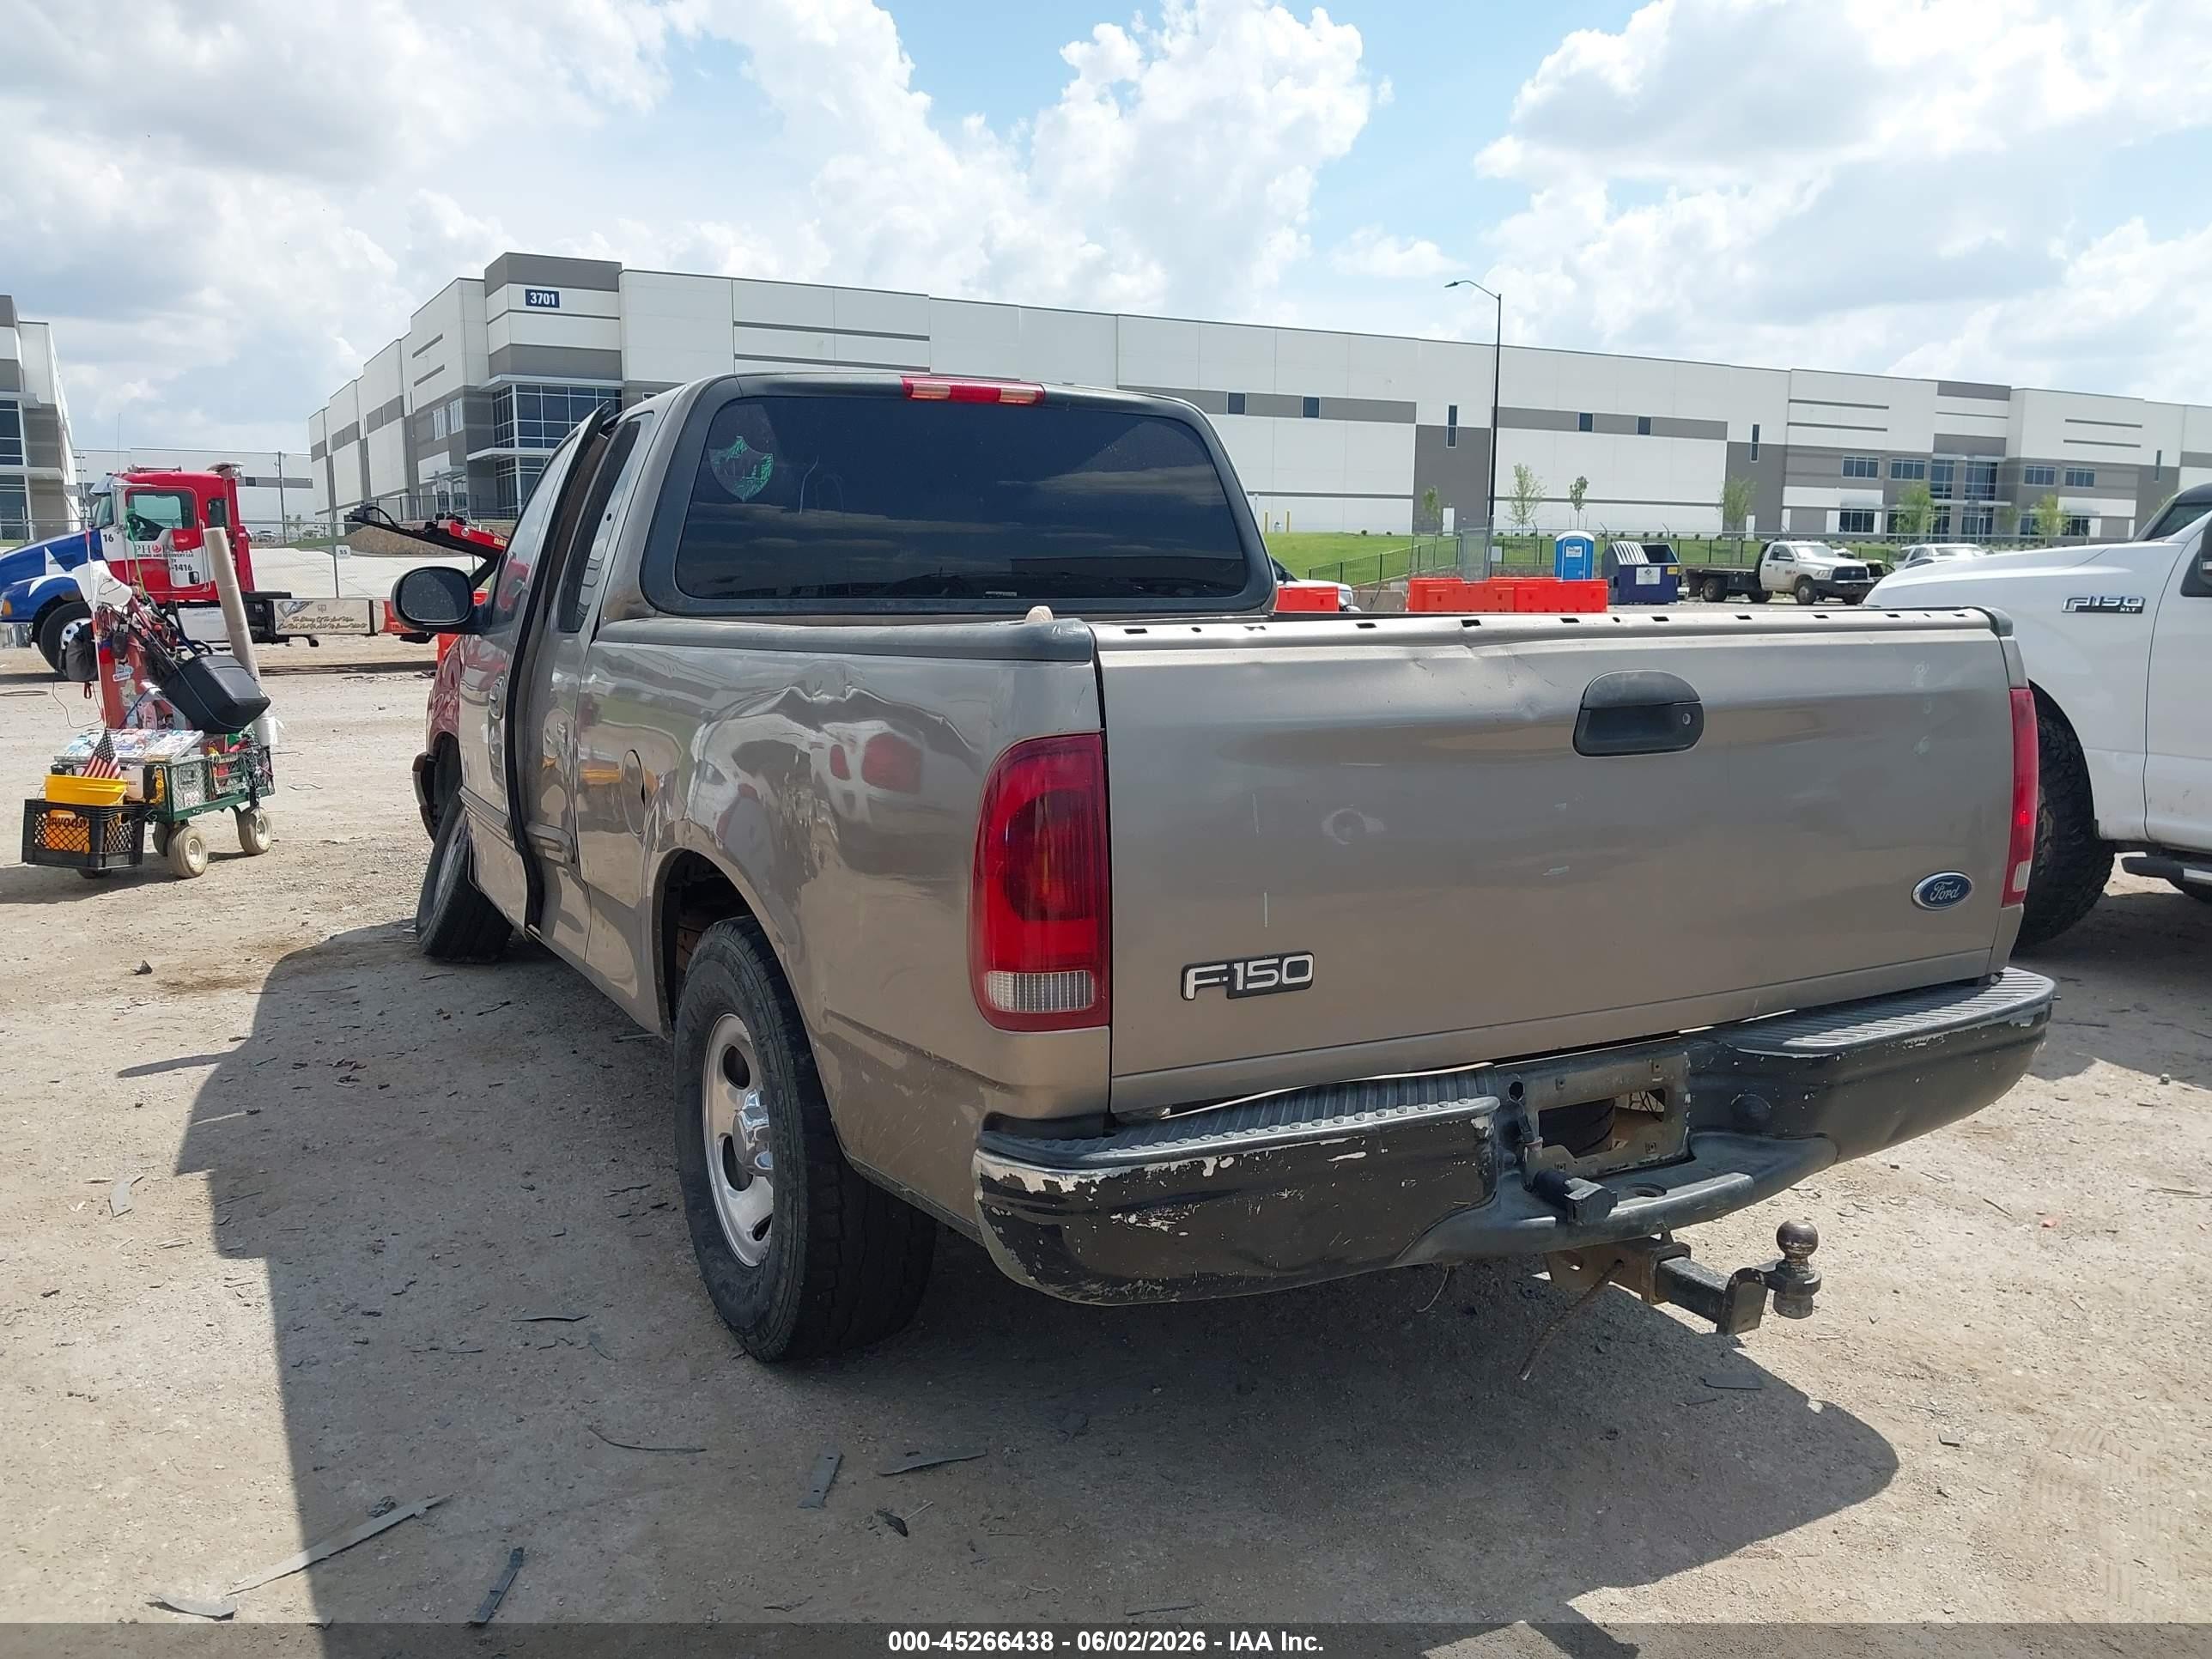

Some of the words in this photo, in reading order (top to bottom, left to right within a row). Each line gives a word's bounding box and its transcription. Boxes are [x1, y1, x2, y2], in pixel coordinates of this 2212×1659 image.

[530, 291, 556, 306] 3701
[103, 534, 114, 543] 16
[1929, 880, 1961, 902] Ford
[1184, 954, 1315, 1000] F-150
